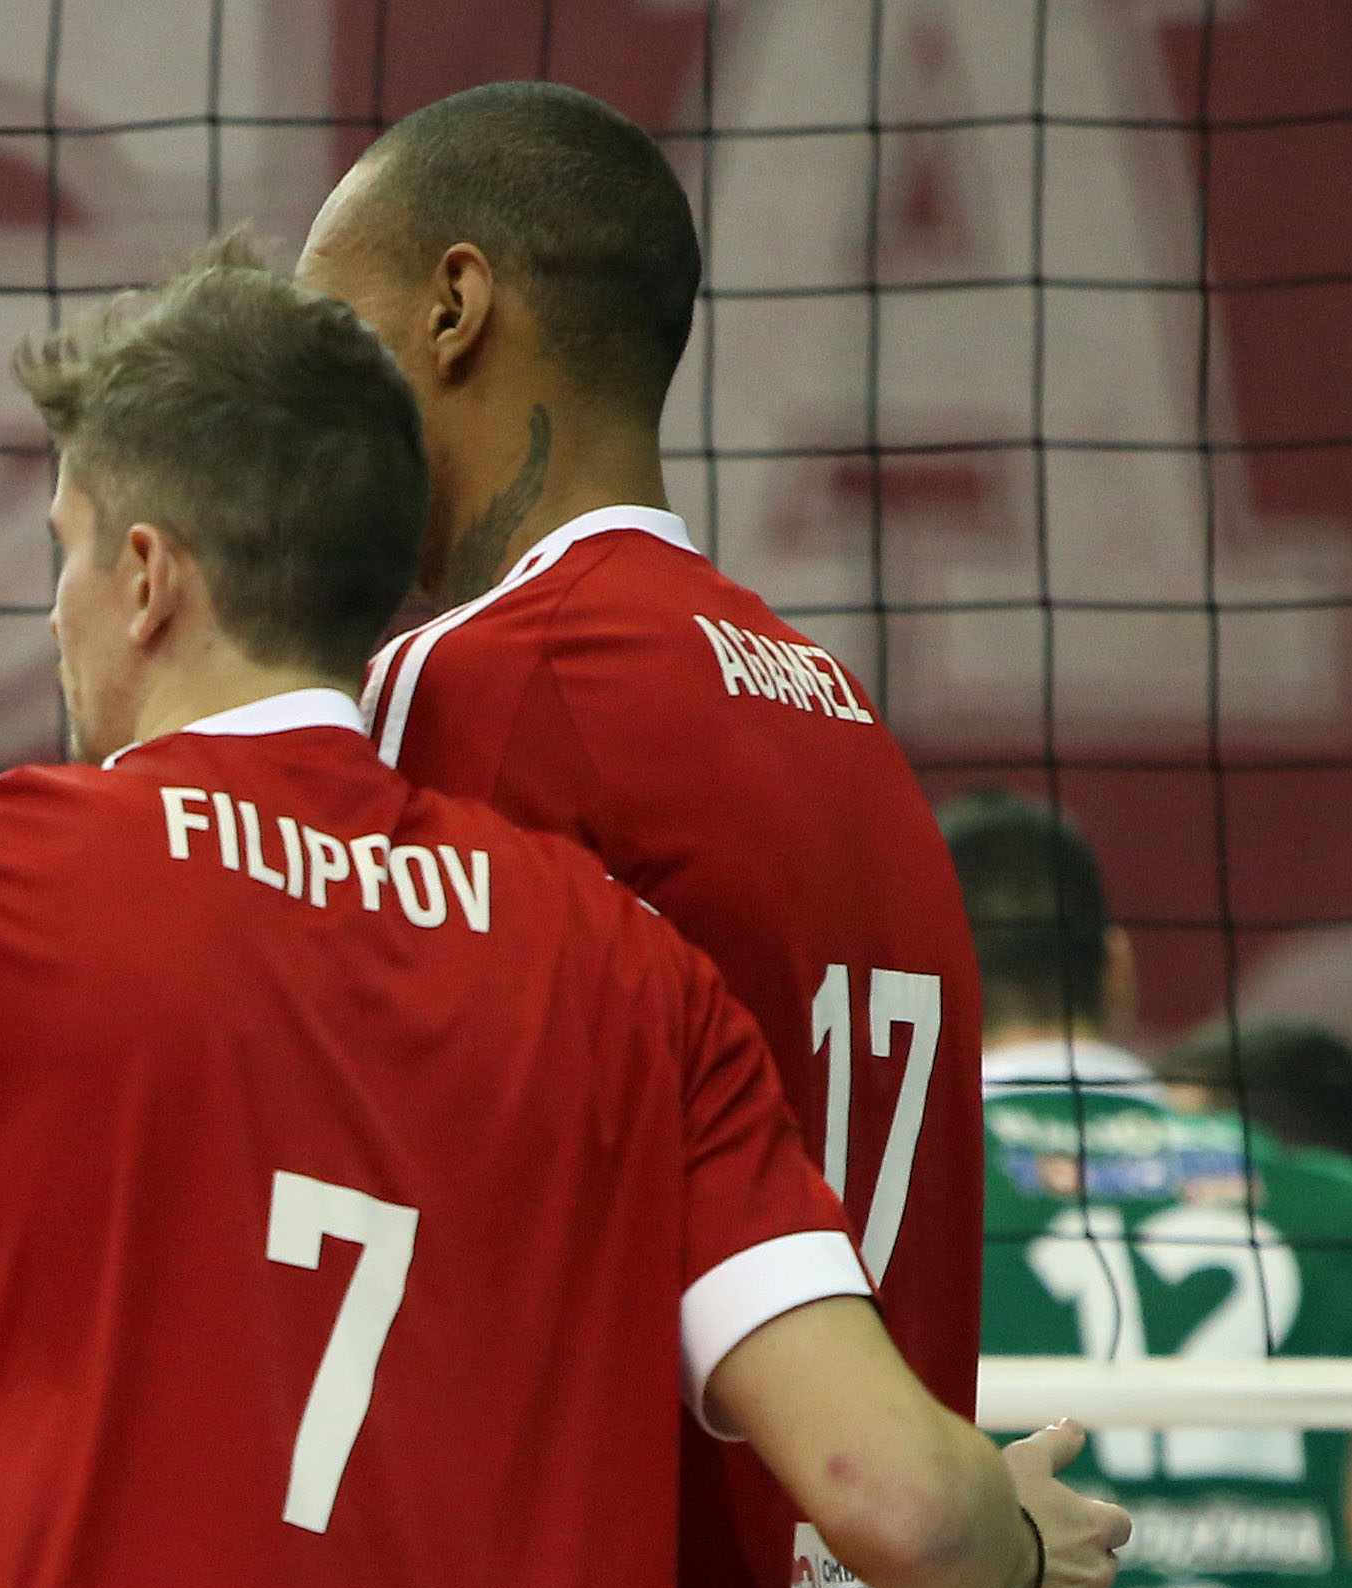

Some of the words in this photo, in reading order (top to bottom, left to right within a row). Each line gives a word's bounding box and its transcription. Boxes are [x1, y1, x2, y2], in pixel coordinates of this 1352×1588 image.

[693, 613, 874, 724] AGAMEZ
[811, 963, 943, 1289] 17
[266, 1171, 420, 1534] 7
[1024, 1205, 1307, 1484] 12
